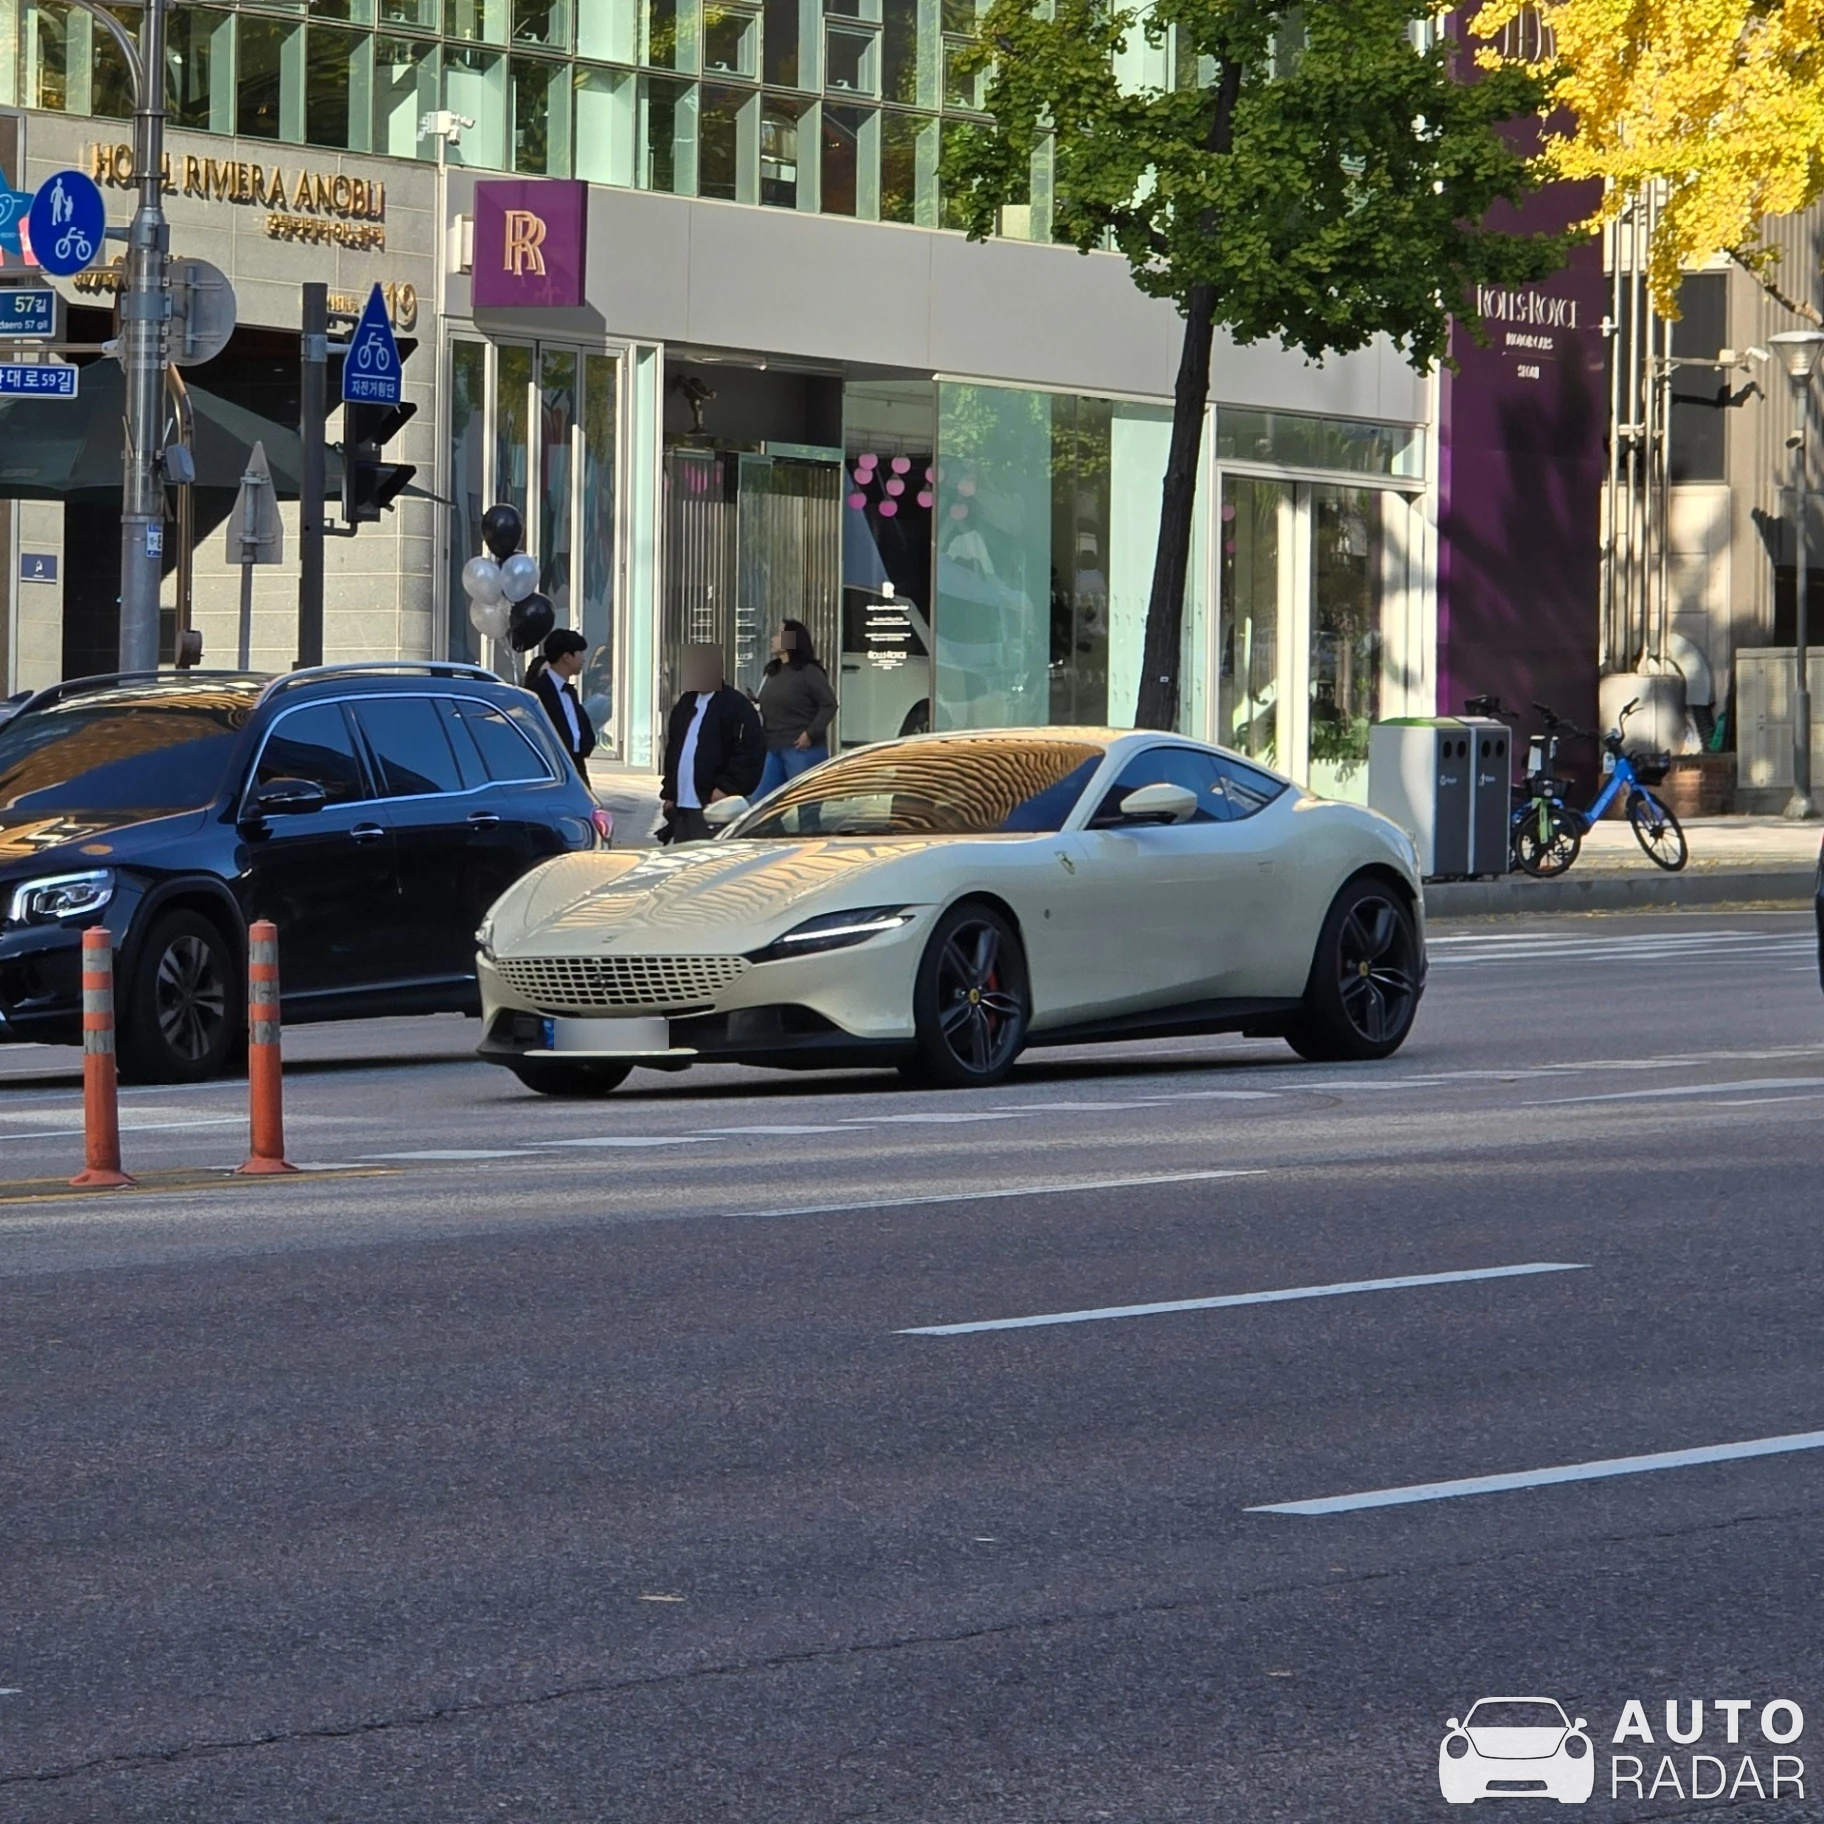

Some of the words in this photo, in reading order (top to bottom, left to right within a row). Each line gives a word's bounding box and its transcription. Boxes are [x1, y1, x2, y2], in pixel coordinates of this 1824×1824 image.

[90, 143, 177, 188] HOL
[183, 154, 286, 205] RIVIERA
[294, 168, 385, 217] ANOBLI
[14, 295, 47, 313] 57길
[24, 319, 35, 329] 57
[37, 319, 48, 331] gil
